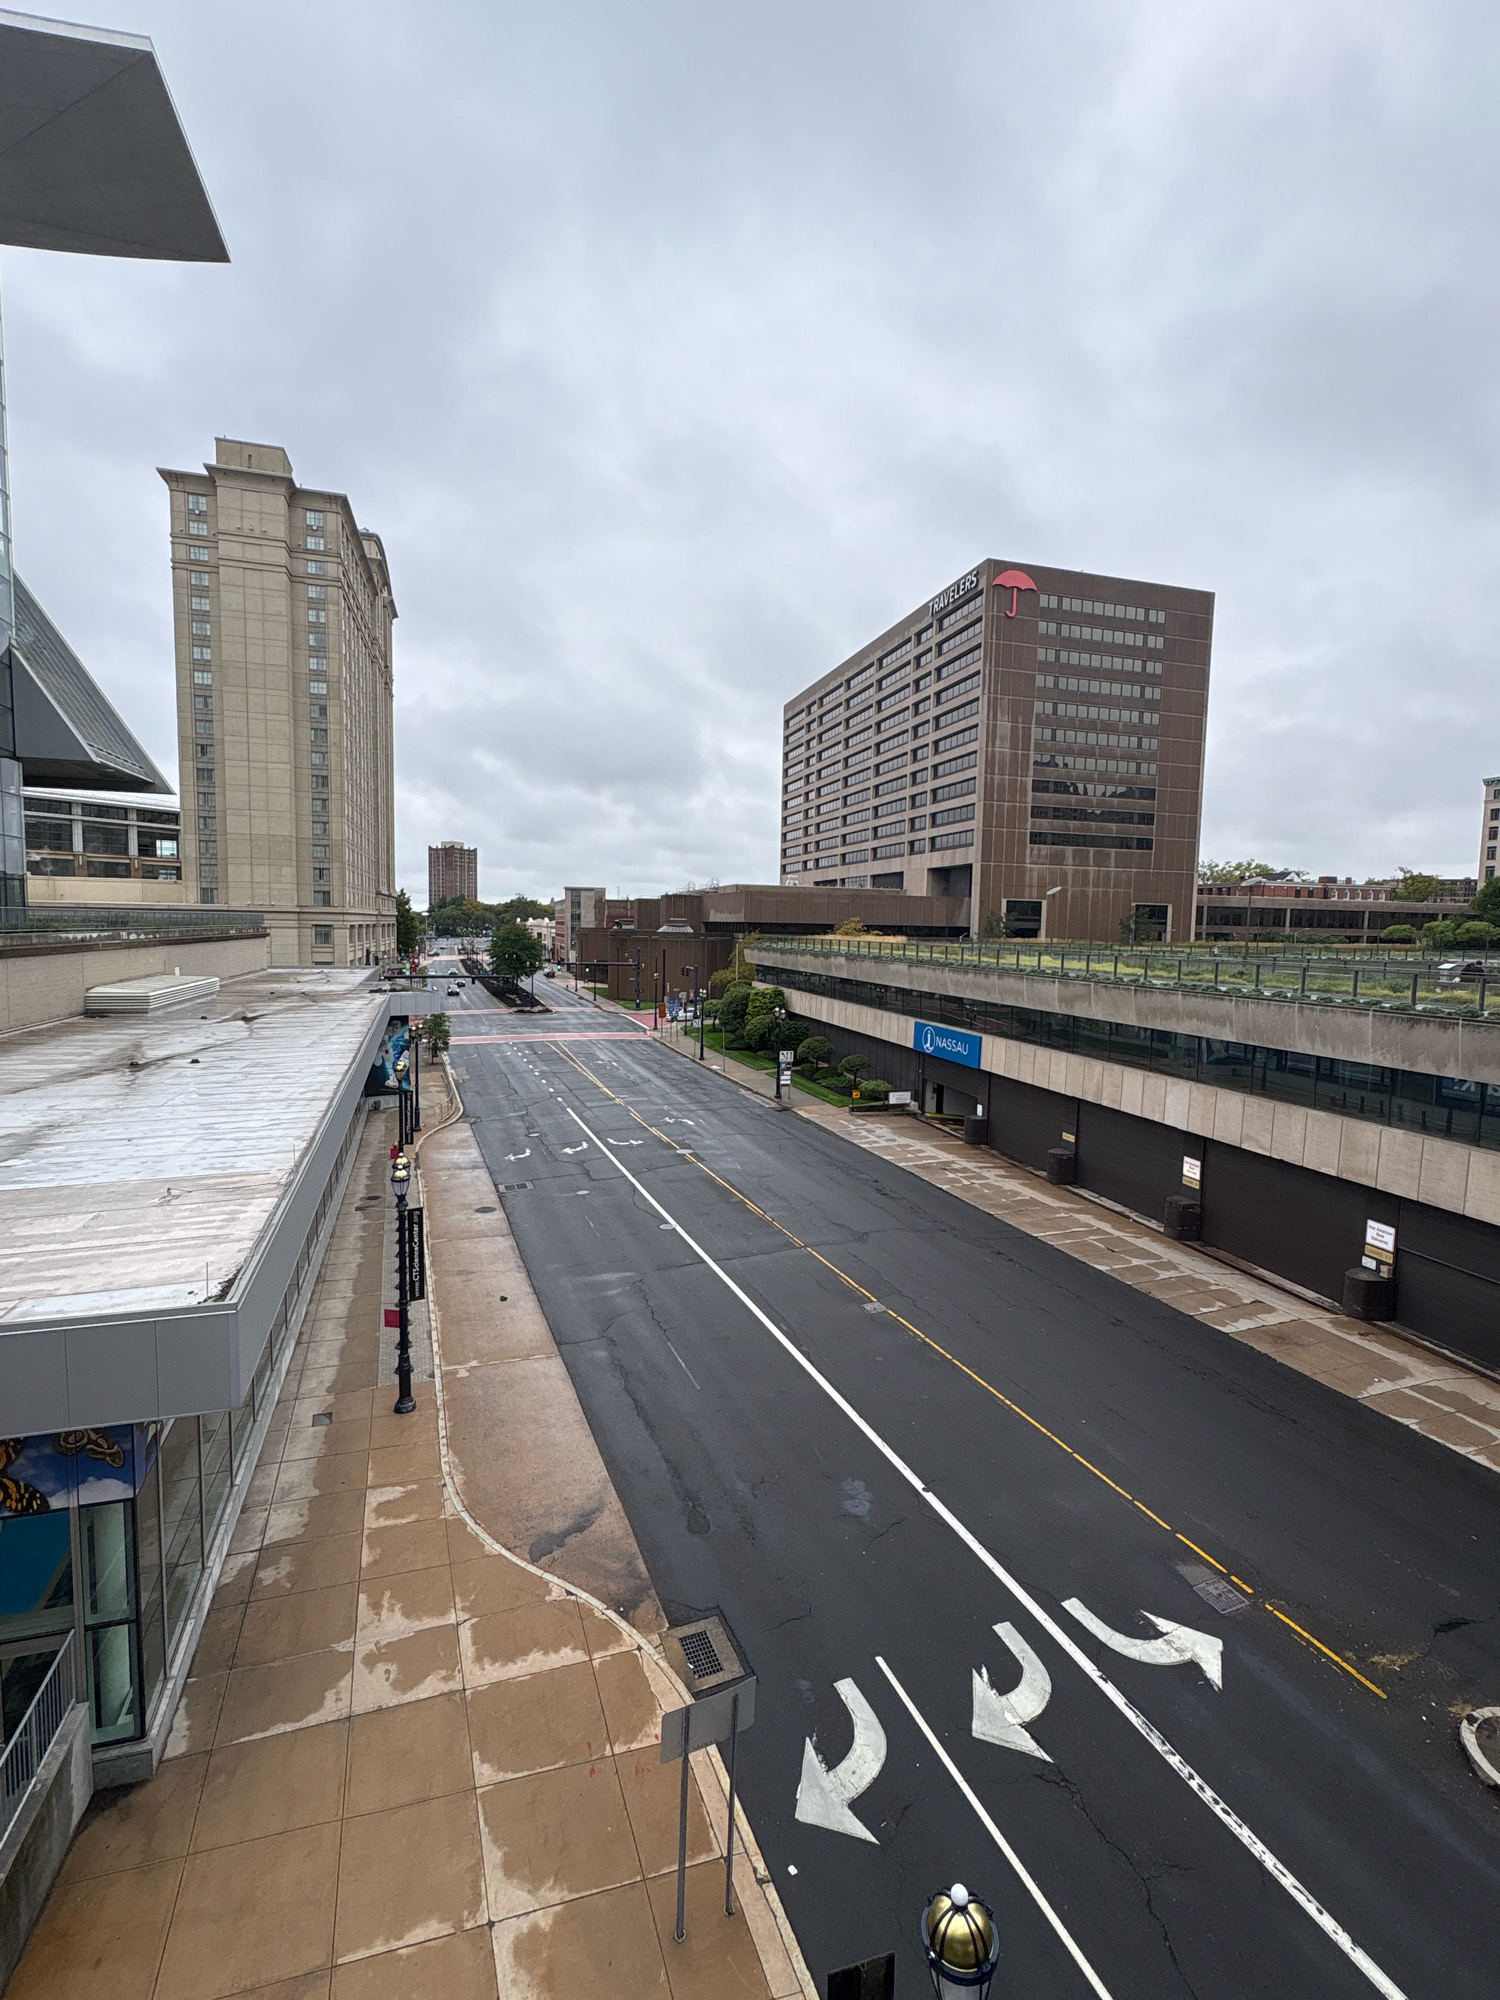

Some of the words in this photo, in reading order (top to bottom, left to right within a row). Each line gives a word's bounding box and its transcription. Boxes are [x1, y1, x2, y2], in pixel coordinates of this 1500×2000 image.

[928, 570, 978, 616] TRAVELERS
[935, 1035, 969, 1055] NASSAU
[411, 1210, 420, 1298] www.CTScienceCenter.org
